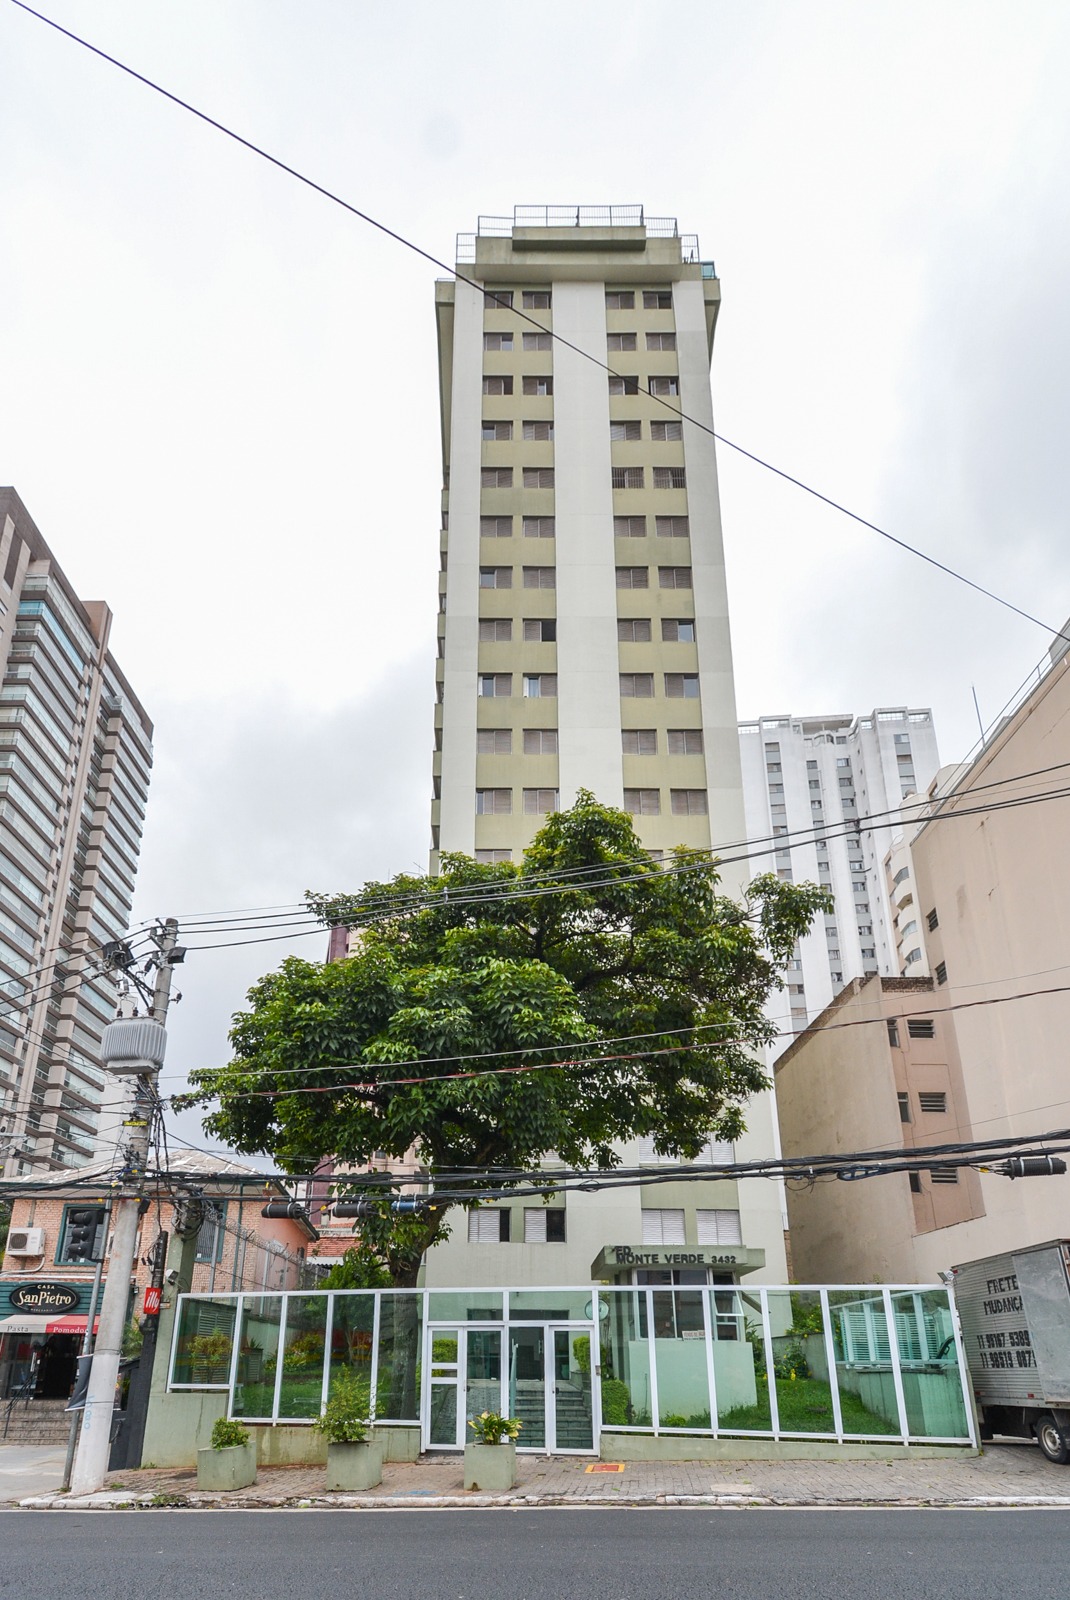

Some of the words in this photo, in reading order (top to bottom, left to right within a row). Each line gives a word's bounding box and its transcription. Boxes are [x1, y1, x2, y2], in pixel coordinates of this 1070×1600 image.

[616, 1254, 659, 1264] MONTE
[665, 1254, 704, 1264] VERDE
[711, 1255, 736, 1264] 3432
[17, 1290, 72, 1306] SanPietro
[146, 1291, 160, 1312] illy
[977, 1334, 986, 1350] 11
[980, 1352, 989, 1369] 11
